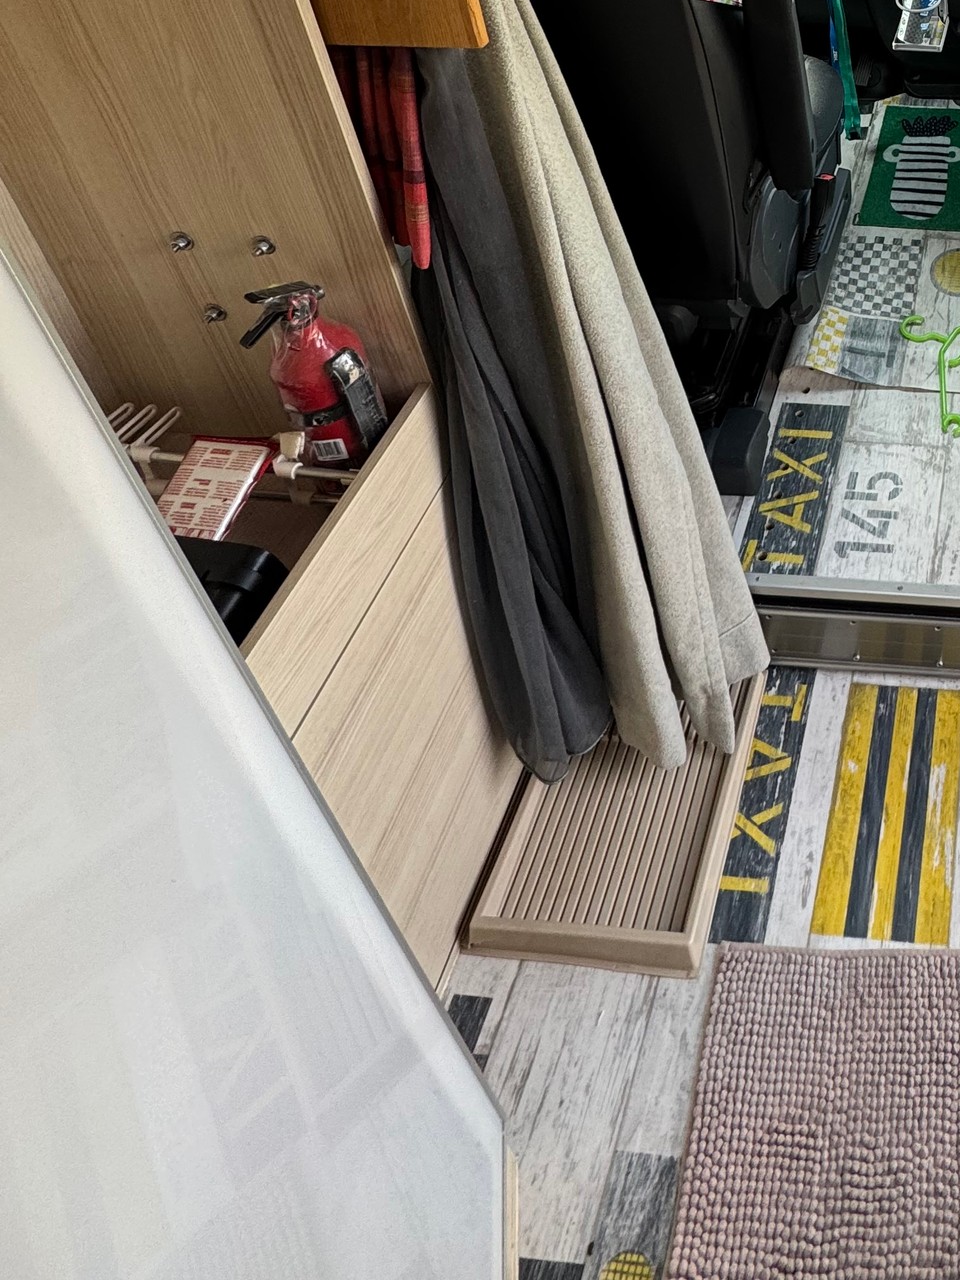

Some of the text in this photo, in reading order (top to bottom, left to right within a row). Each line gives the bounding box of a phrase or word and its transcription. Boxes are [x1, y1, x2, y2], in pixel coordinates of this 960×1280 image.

[742, 427, 834, 571] TAXI
[833, 471, 904, 559] 145
[719, 682, 808, 897] TAXI
